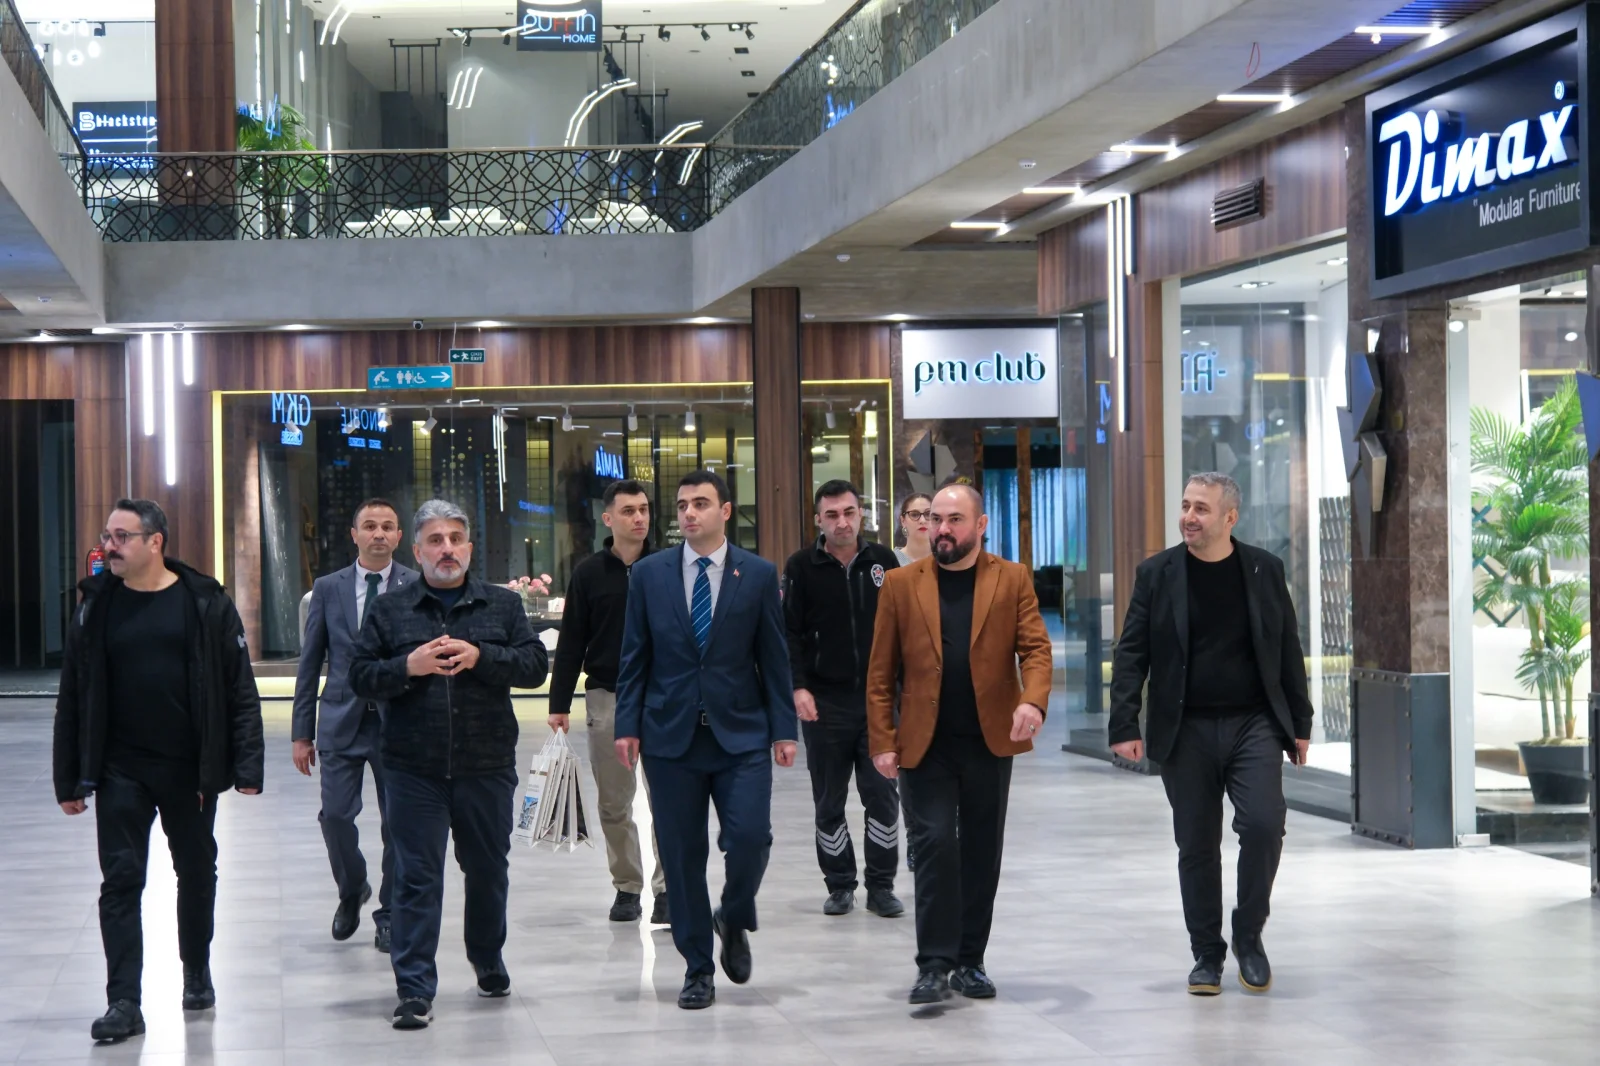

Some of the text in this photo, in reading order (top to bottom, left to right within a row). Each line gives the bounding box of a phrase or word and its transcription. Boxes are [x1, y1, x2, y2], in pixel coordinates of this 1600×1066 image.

[562, 34, 596, 43] HOME
[1379, 104, 1574, 217] Dimax
[1529, 181, 1581, 213] Furniture
[914, 351, 1046, 395] pm club
